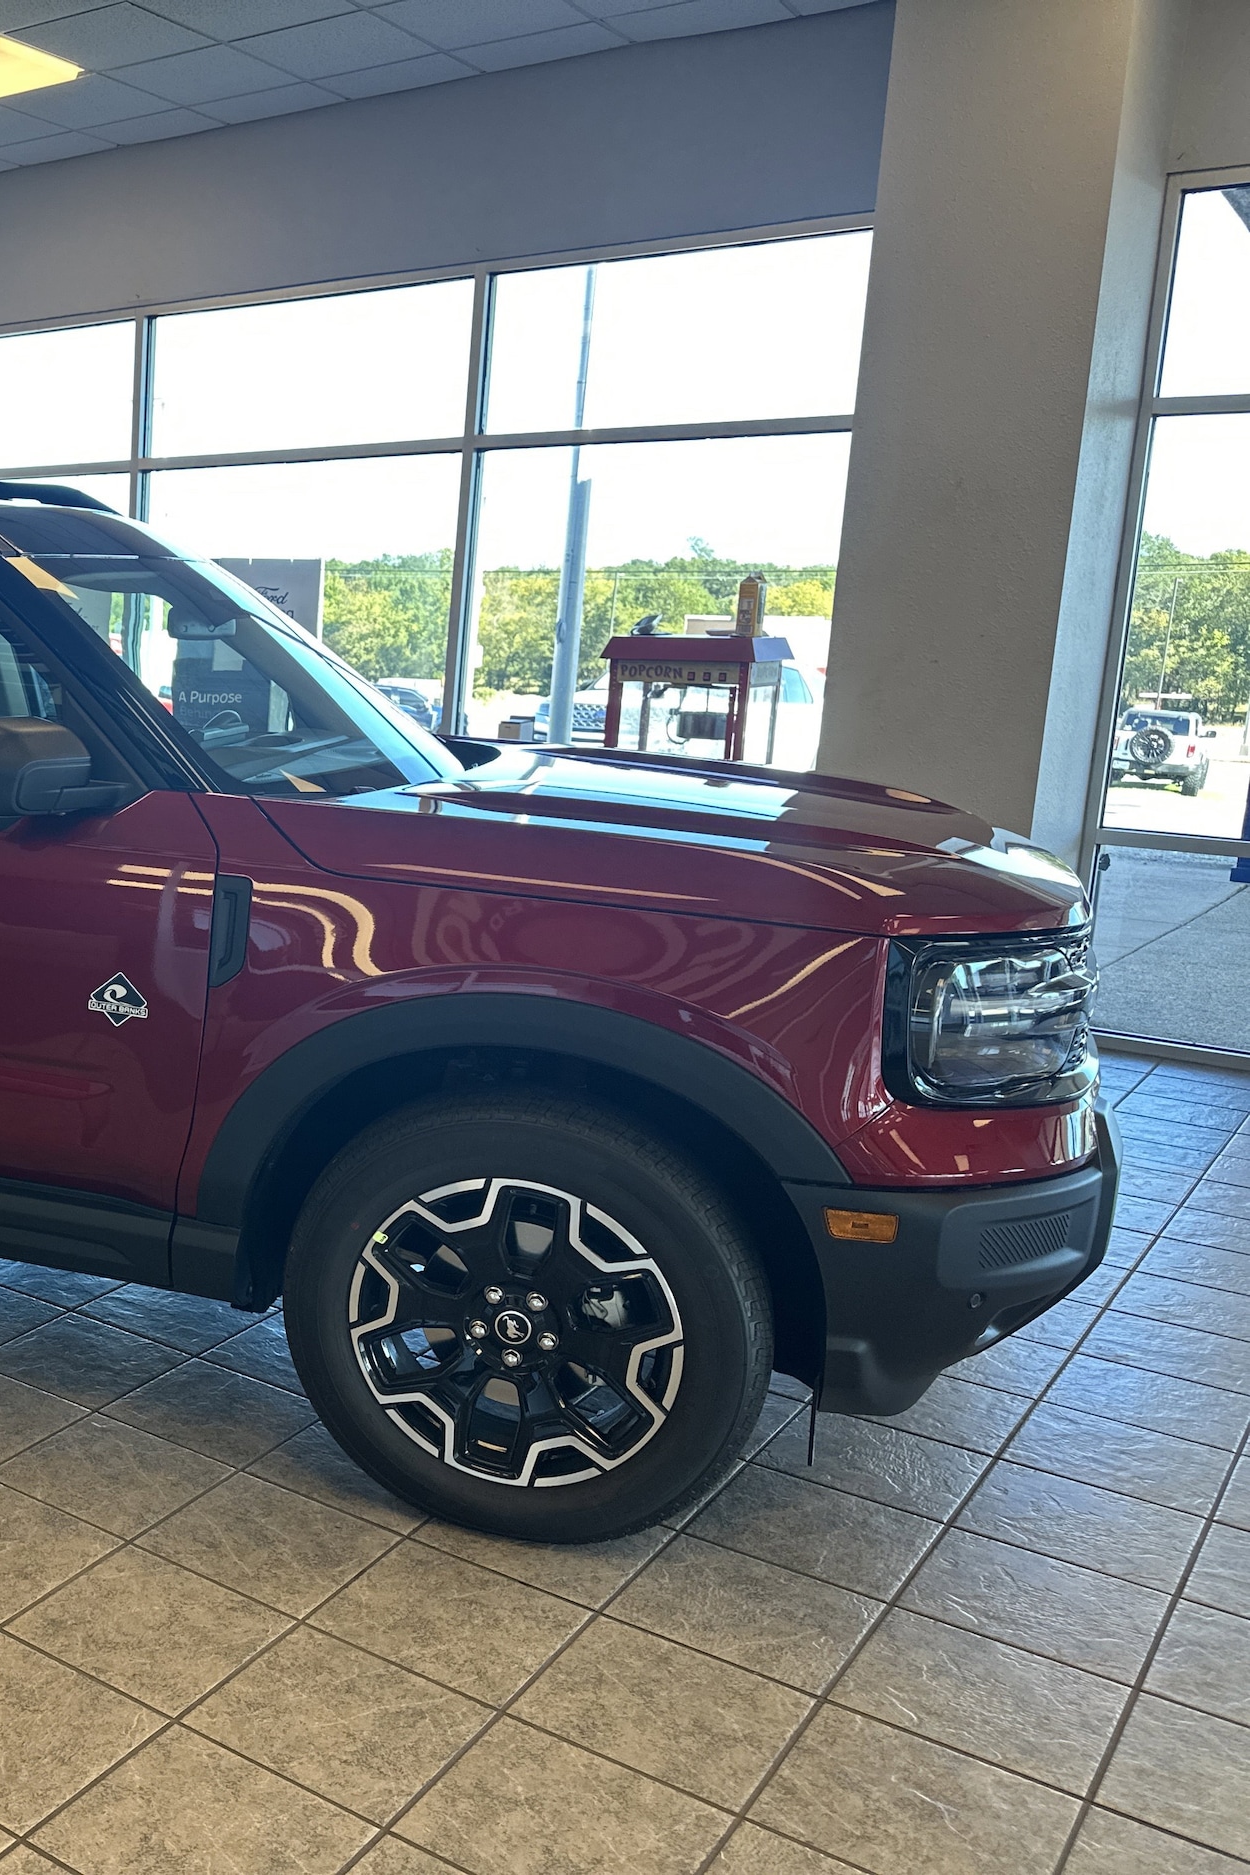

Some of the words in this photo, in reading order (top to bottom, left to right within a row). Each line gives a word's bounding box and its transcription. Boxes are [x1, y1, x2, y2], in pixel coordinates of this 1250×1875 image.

[620, 664, 683, 679] POPCORN
[178, 691, 187, 703] A
[190, 690, 242, 705] Purpose
[90, 1002, 117, 1011] OUTER
[119, 1006, 146, 1016] BANKS
